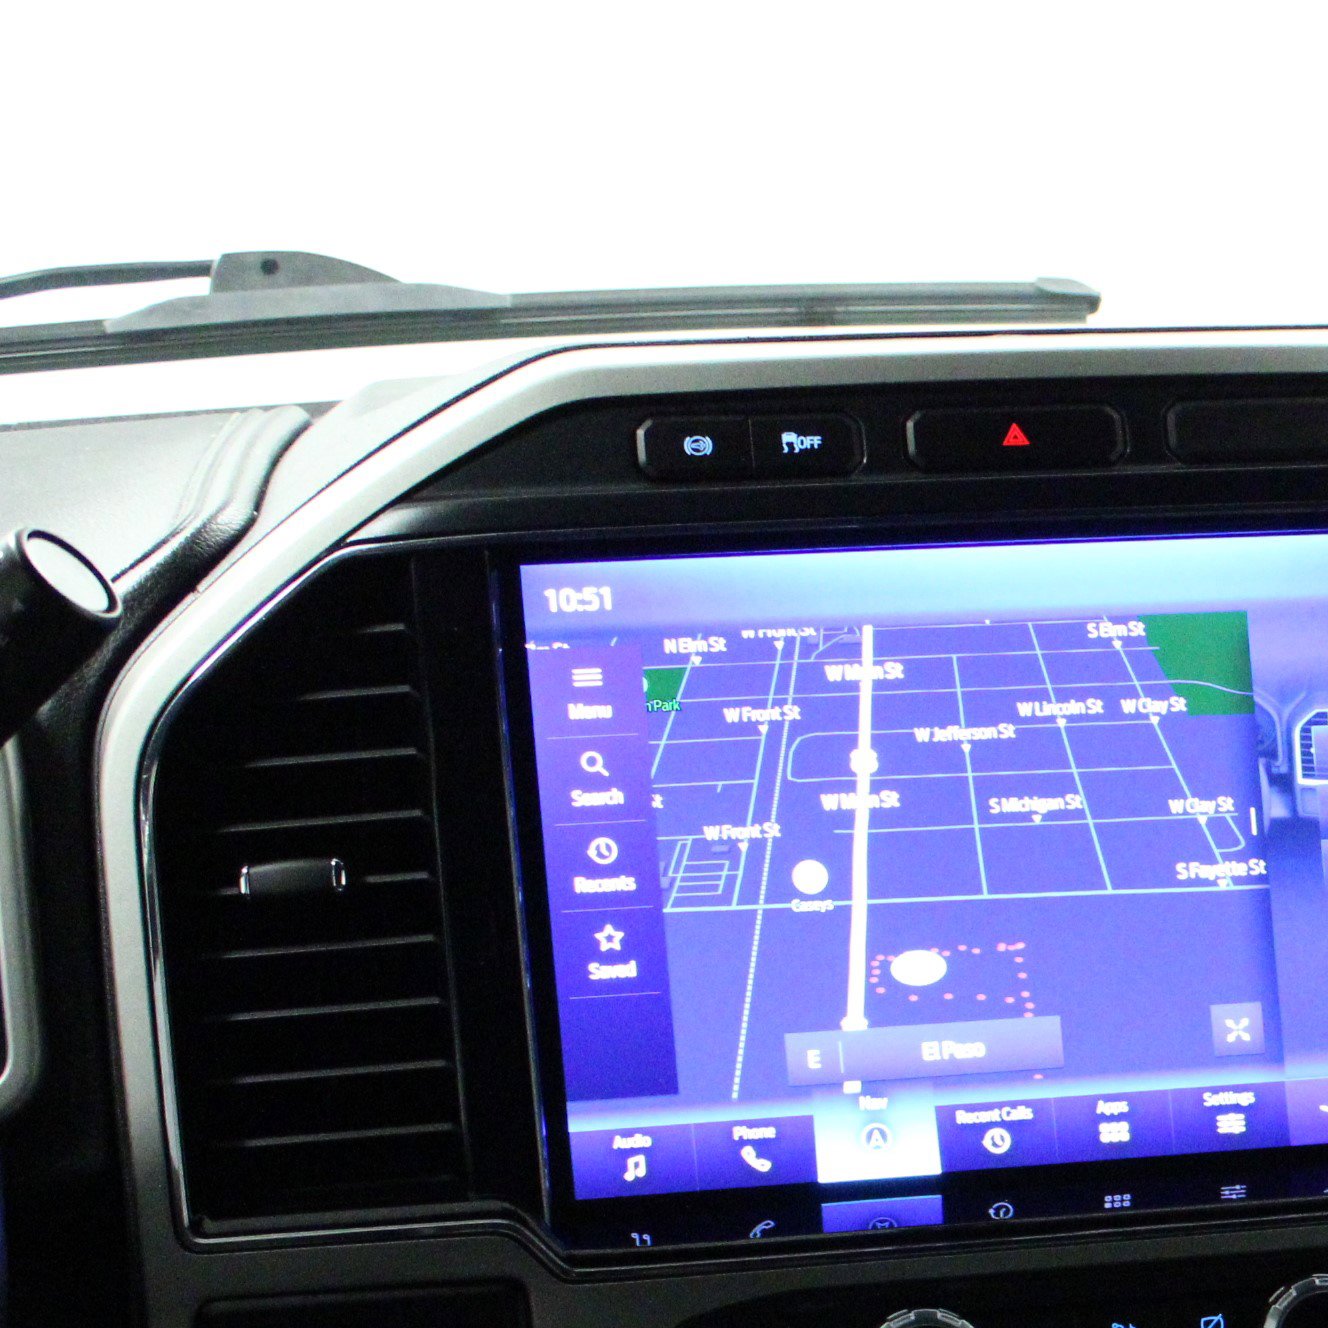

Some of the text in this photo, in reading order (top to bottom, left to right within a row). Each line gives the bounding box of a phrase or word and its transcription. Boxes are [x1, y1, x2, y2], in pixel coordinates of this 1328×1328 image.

[798, 436, 822, 449] OFF
[543, 585, 613, 613] 10:51
[1087, 623, 1098, 638] S
[1128, 620, 1146, 637] St
[664, 639, 677, 654] N
[709, 636, 727, 652] St
[824, 661, 905, 682] W Mn St
[567, 703, 613, 720] Menu
[653, 699, 682, 712] Park
[723, 704, 801, 723] W Front St
[1016, 698, 1104, 717] W Lincoln St
[1120, 699, 1136, 714] W
[1170, 695, 1187, 712] St
[914, 723, 1016, 742] W Jefferson St
[570, 788, 624, 807] Search
[820, 790, 901, 811] W Mn St
[988, 794, 1083, 814] S Michigan St
[1168, 799, 1184, 815] W
[1217, 796, 1235, 813] St
[703, 821, 781, 841] W Front St
[1175, 862, 1187, 880] S
[1249, 858, 1267, 877] St
[573, 875, 637, 894] Recents
[587, 960, 638, 980] Saved
[806, 1049, 822, 1069] E
[921, 1039, 986, 1061] El Paso
[1096, 1099, 1129, 1116] Apps
[1202, 1091, 1255, 1107] Settings
[955, 1105, 1034, 1124] Recent Calls
[612, 1133, 652, 1150] Audio
[732, 1125, 776, 1141] Phone
